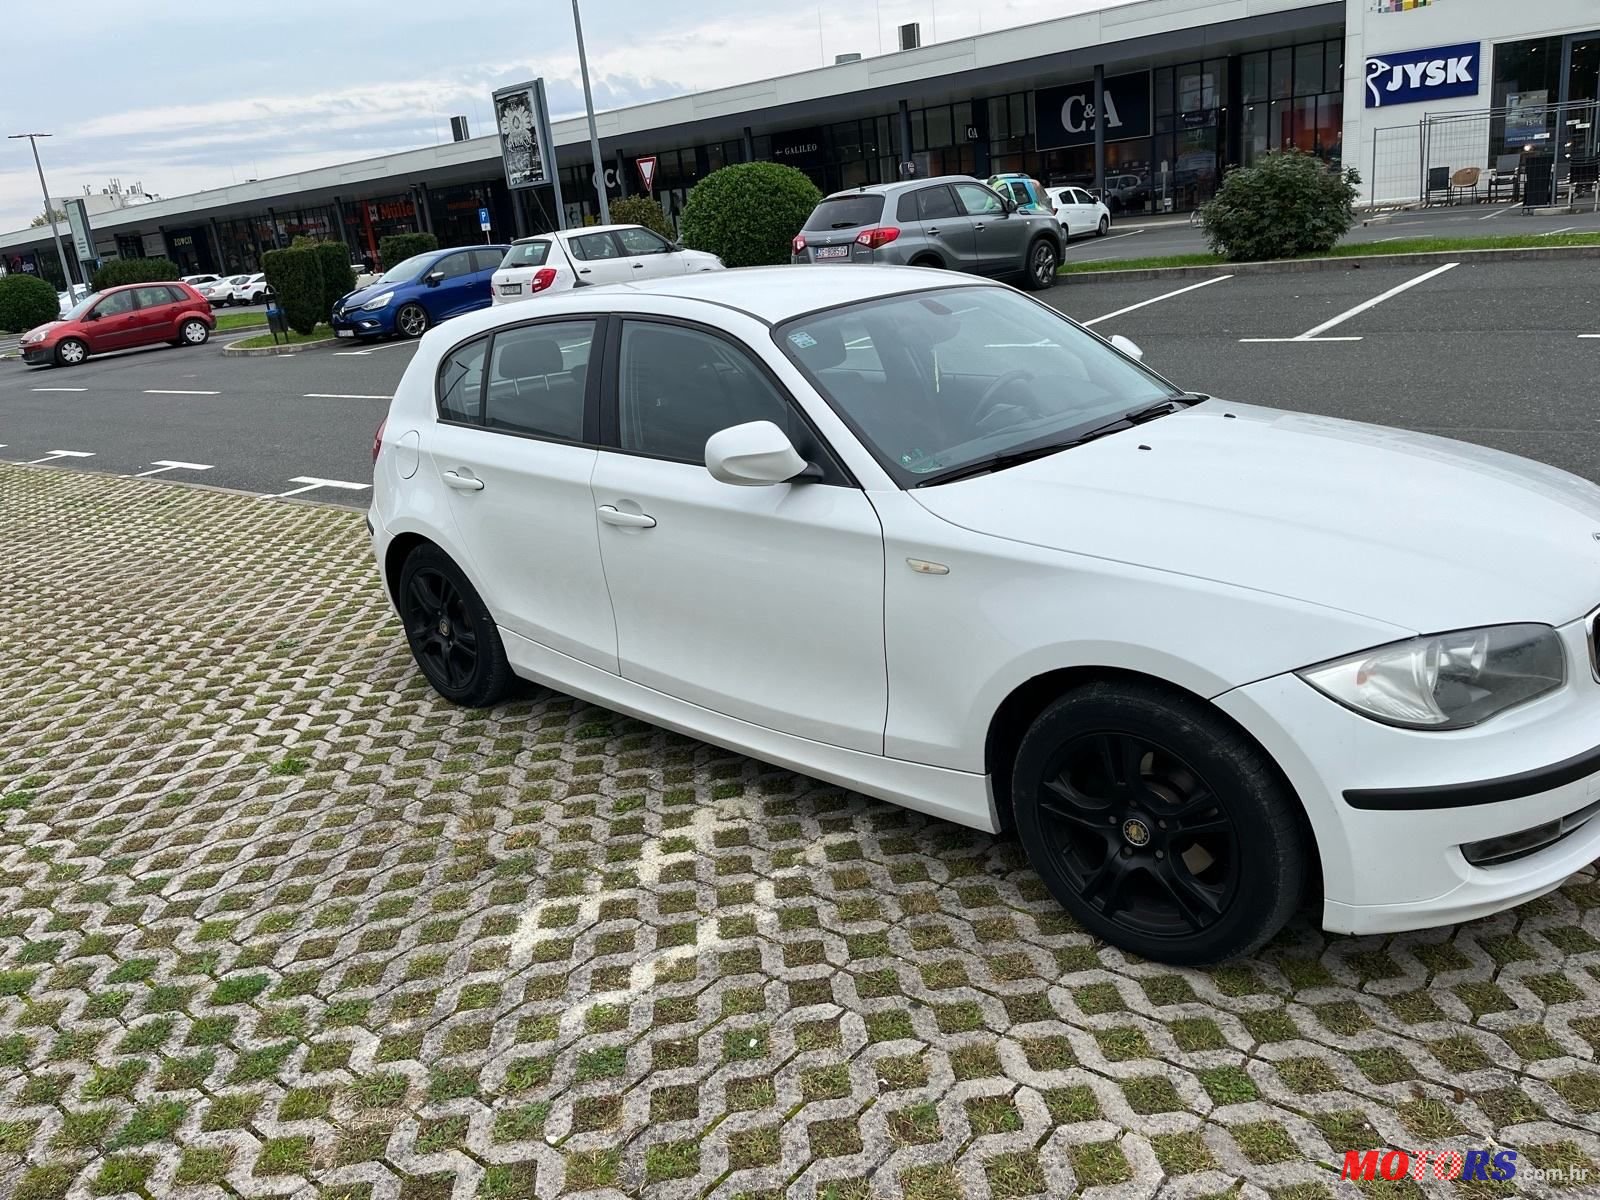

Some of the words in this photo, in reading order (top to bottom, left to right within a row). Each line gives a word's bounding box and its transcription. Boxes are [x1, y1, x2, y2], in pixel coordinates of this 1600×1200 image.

[1386, 55, 1473, 91] JYSK
[1061, 90, 1123, 133] C&A
[784, 143, 818, 155] GALILEO
[481, 211, 486, 221] P
